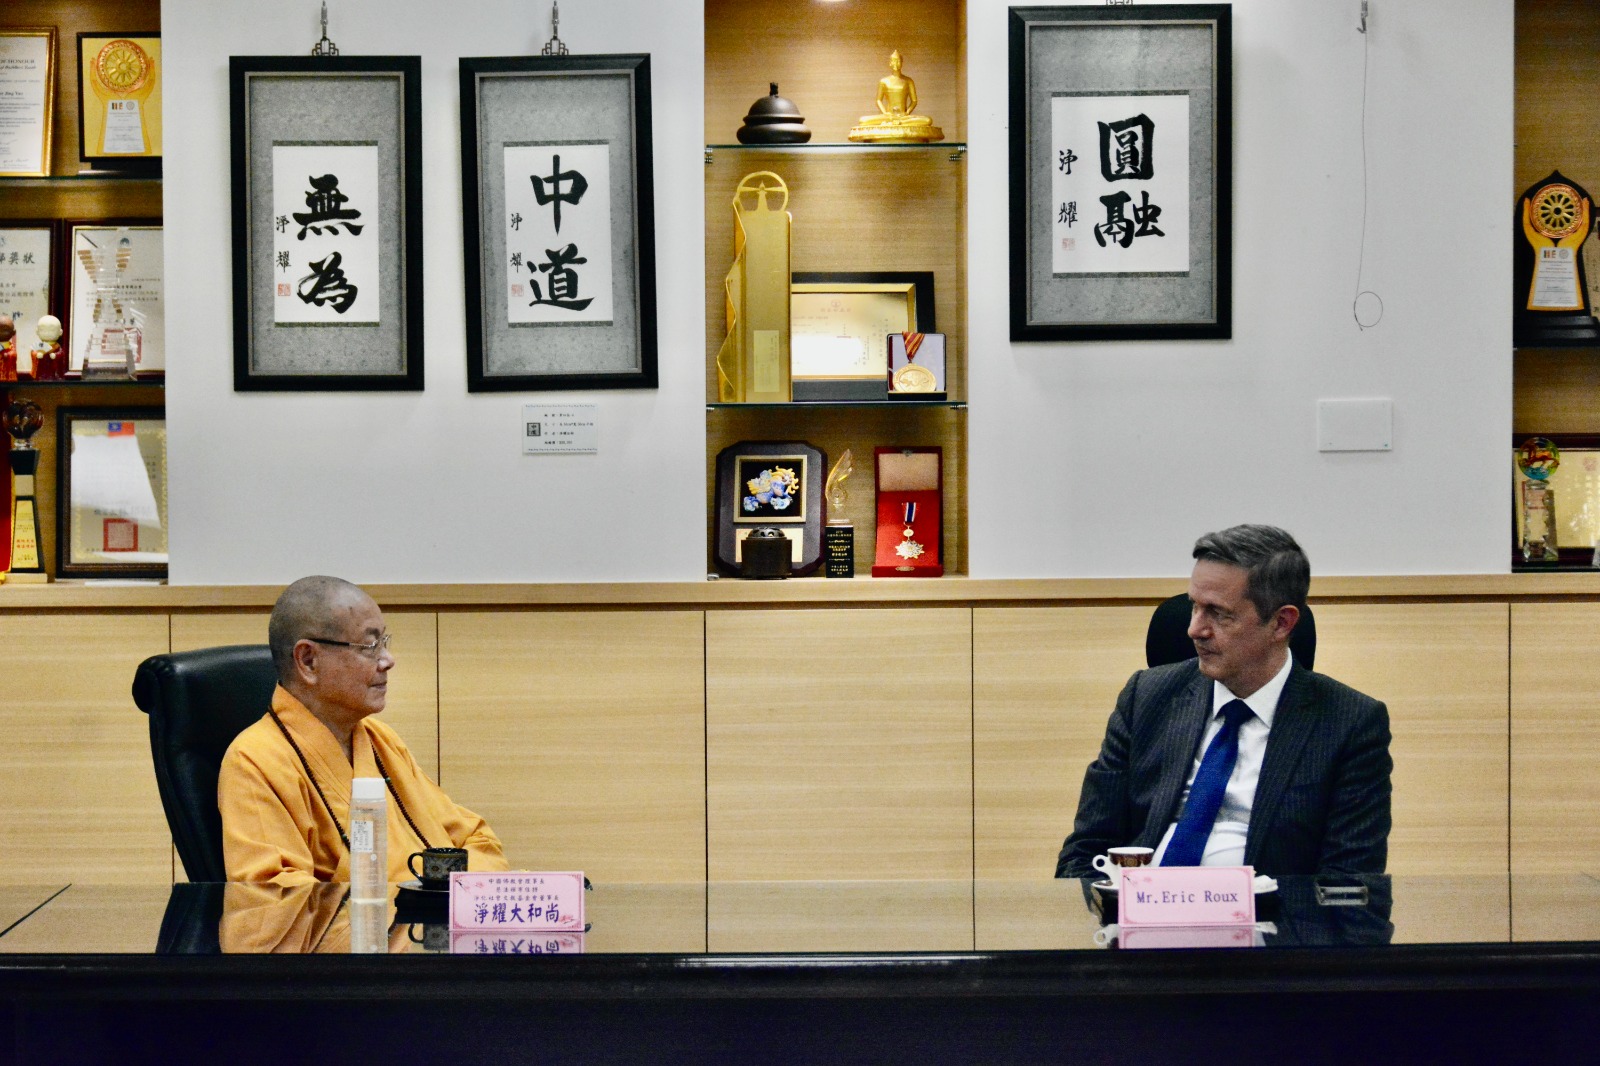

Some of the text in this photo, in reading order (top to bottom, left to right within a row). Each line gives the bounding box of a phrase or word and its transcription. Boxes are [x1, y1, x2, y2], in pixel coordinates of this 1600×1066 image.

[293, 174, 364, 314] 無為
[526, 154, 595, 311] 中道
[1094, 113, 1165, 248] 圓融
[474, 902, 560, 924] 淨耀大和尚
[1204, 890, 1238, 903] Roux
